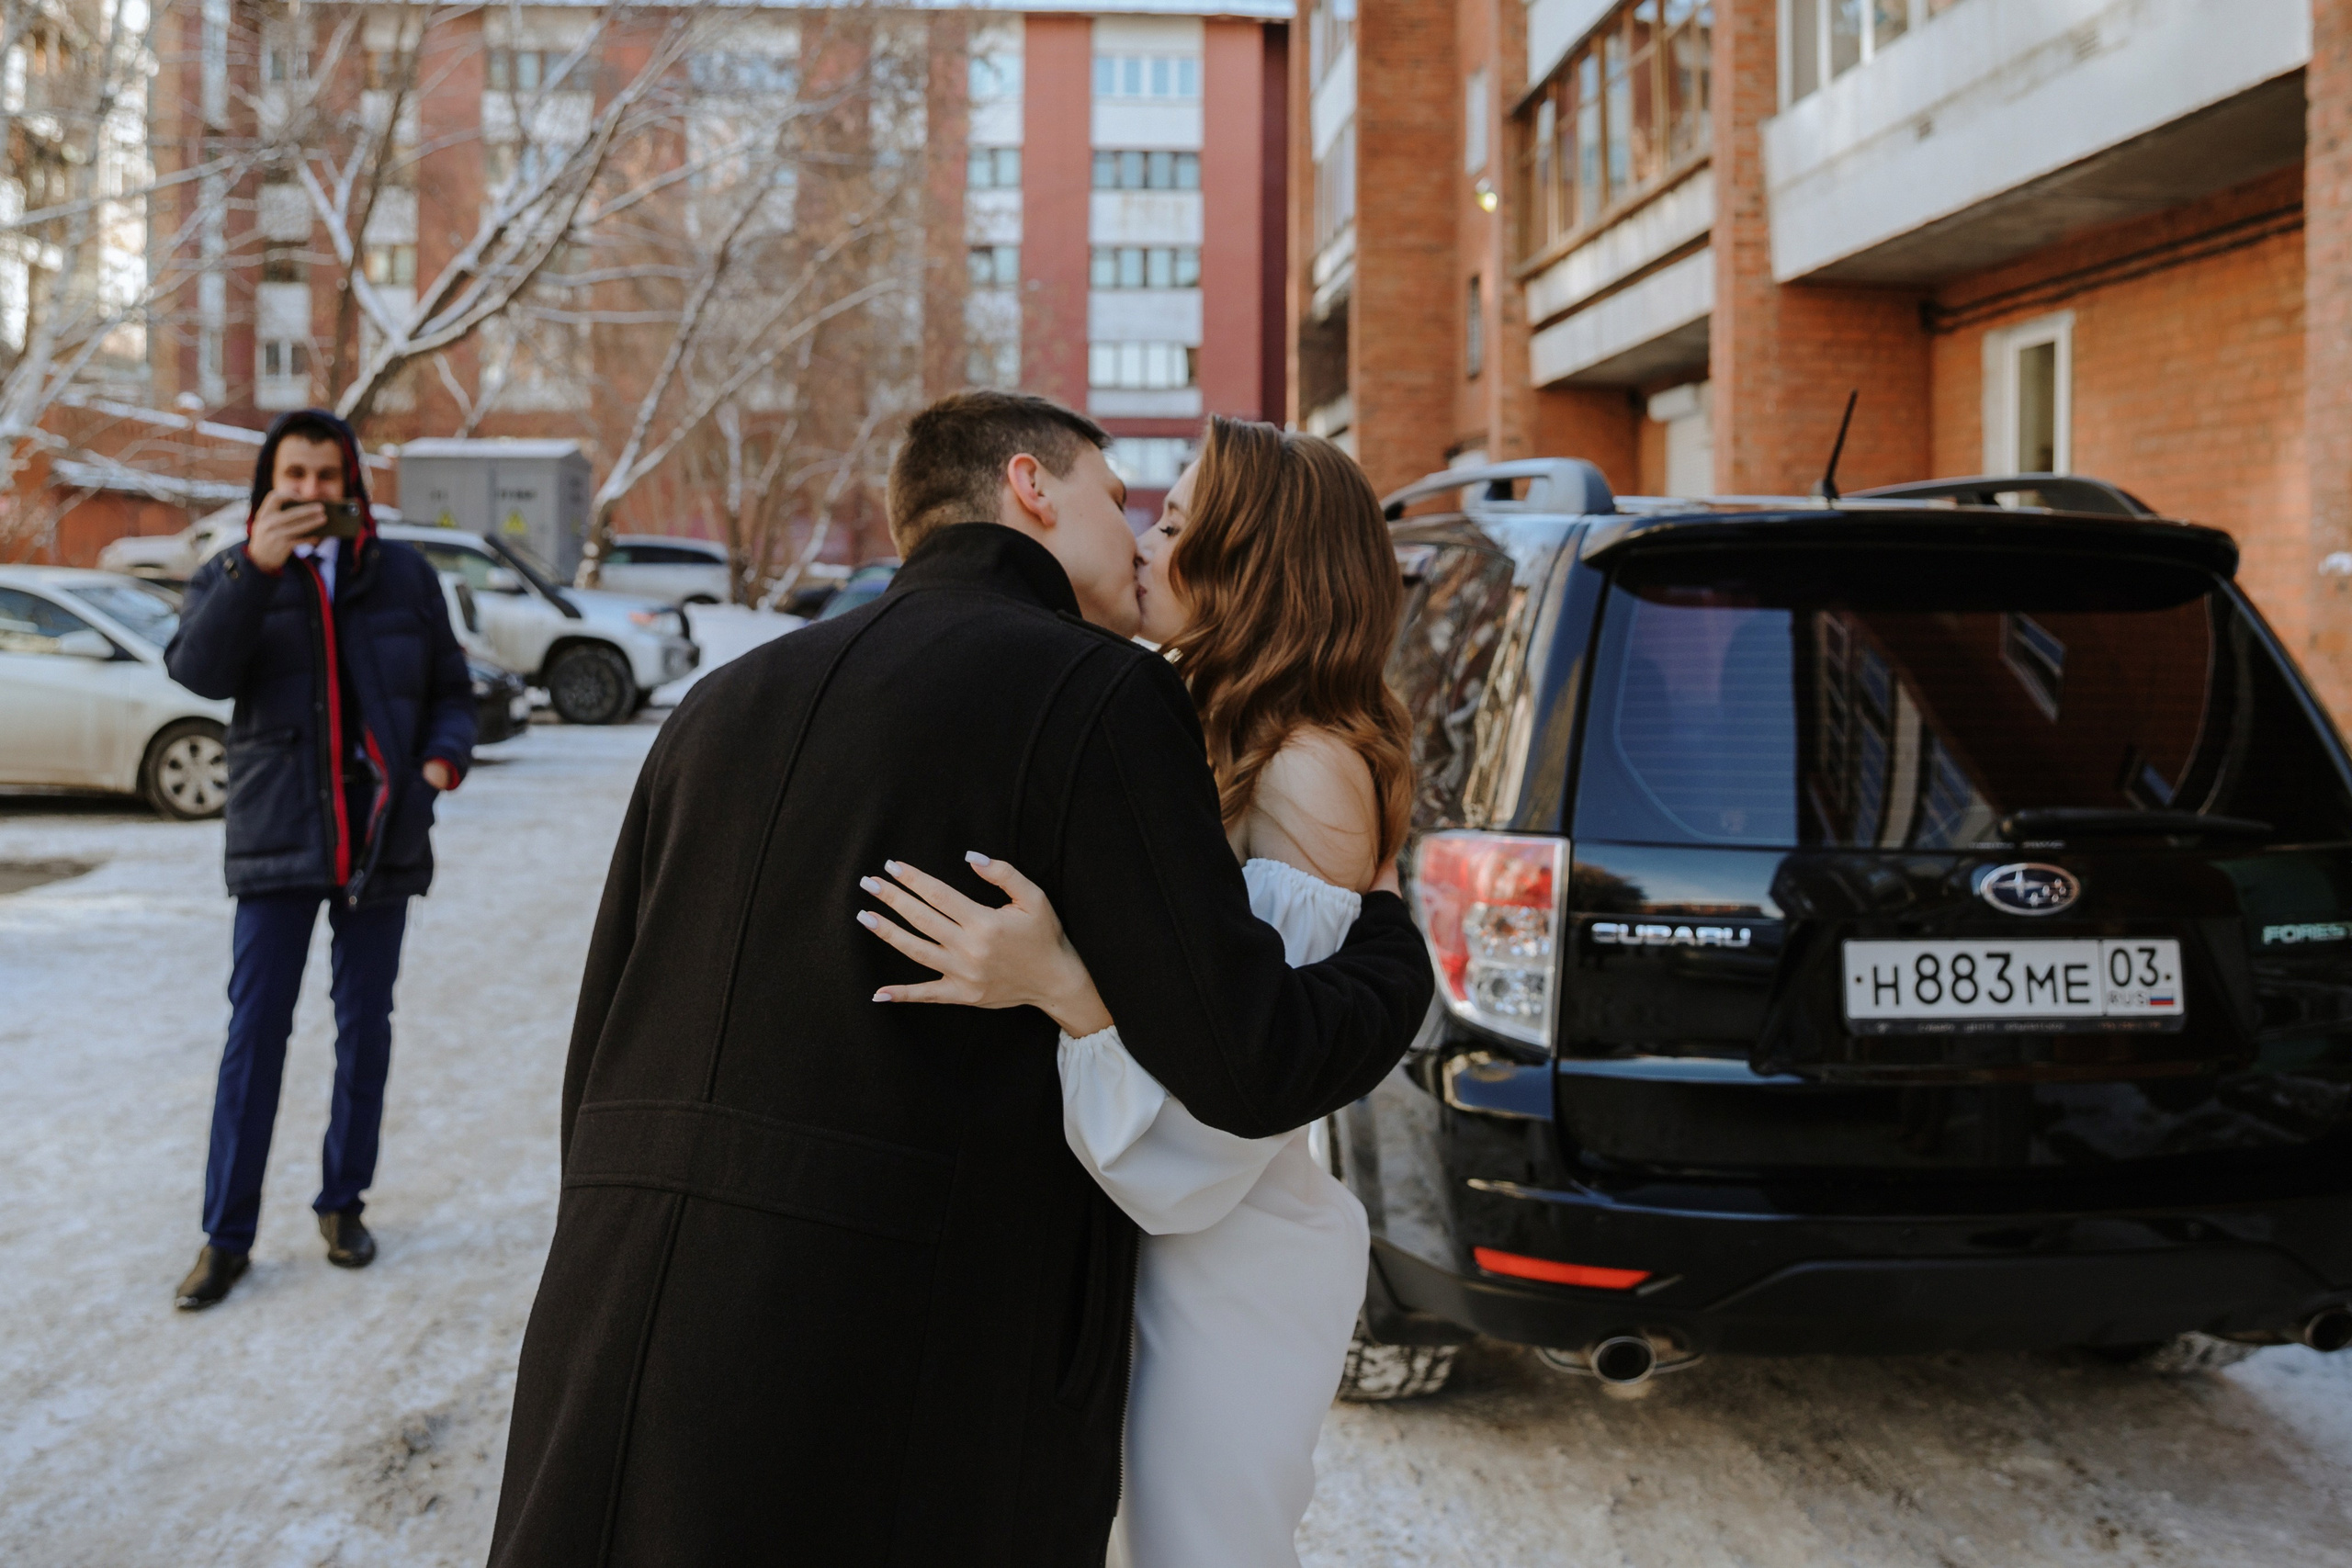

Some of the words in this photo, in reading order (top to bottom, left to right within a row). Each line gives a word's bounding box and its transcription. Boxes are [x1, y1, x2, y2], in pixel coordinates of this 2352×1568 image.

[1591, 922, 1751, 947] SUBARU
[2262, 921, 2352, 945] FORES
[2109, 947, 2159, 987] 03
[2108, 990, 2147, 1009] RUS
